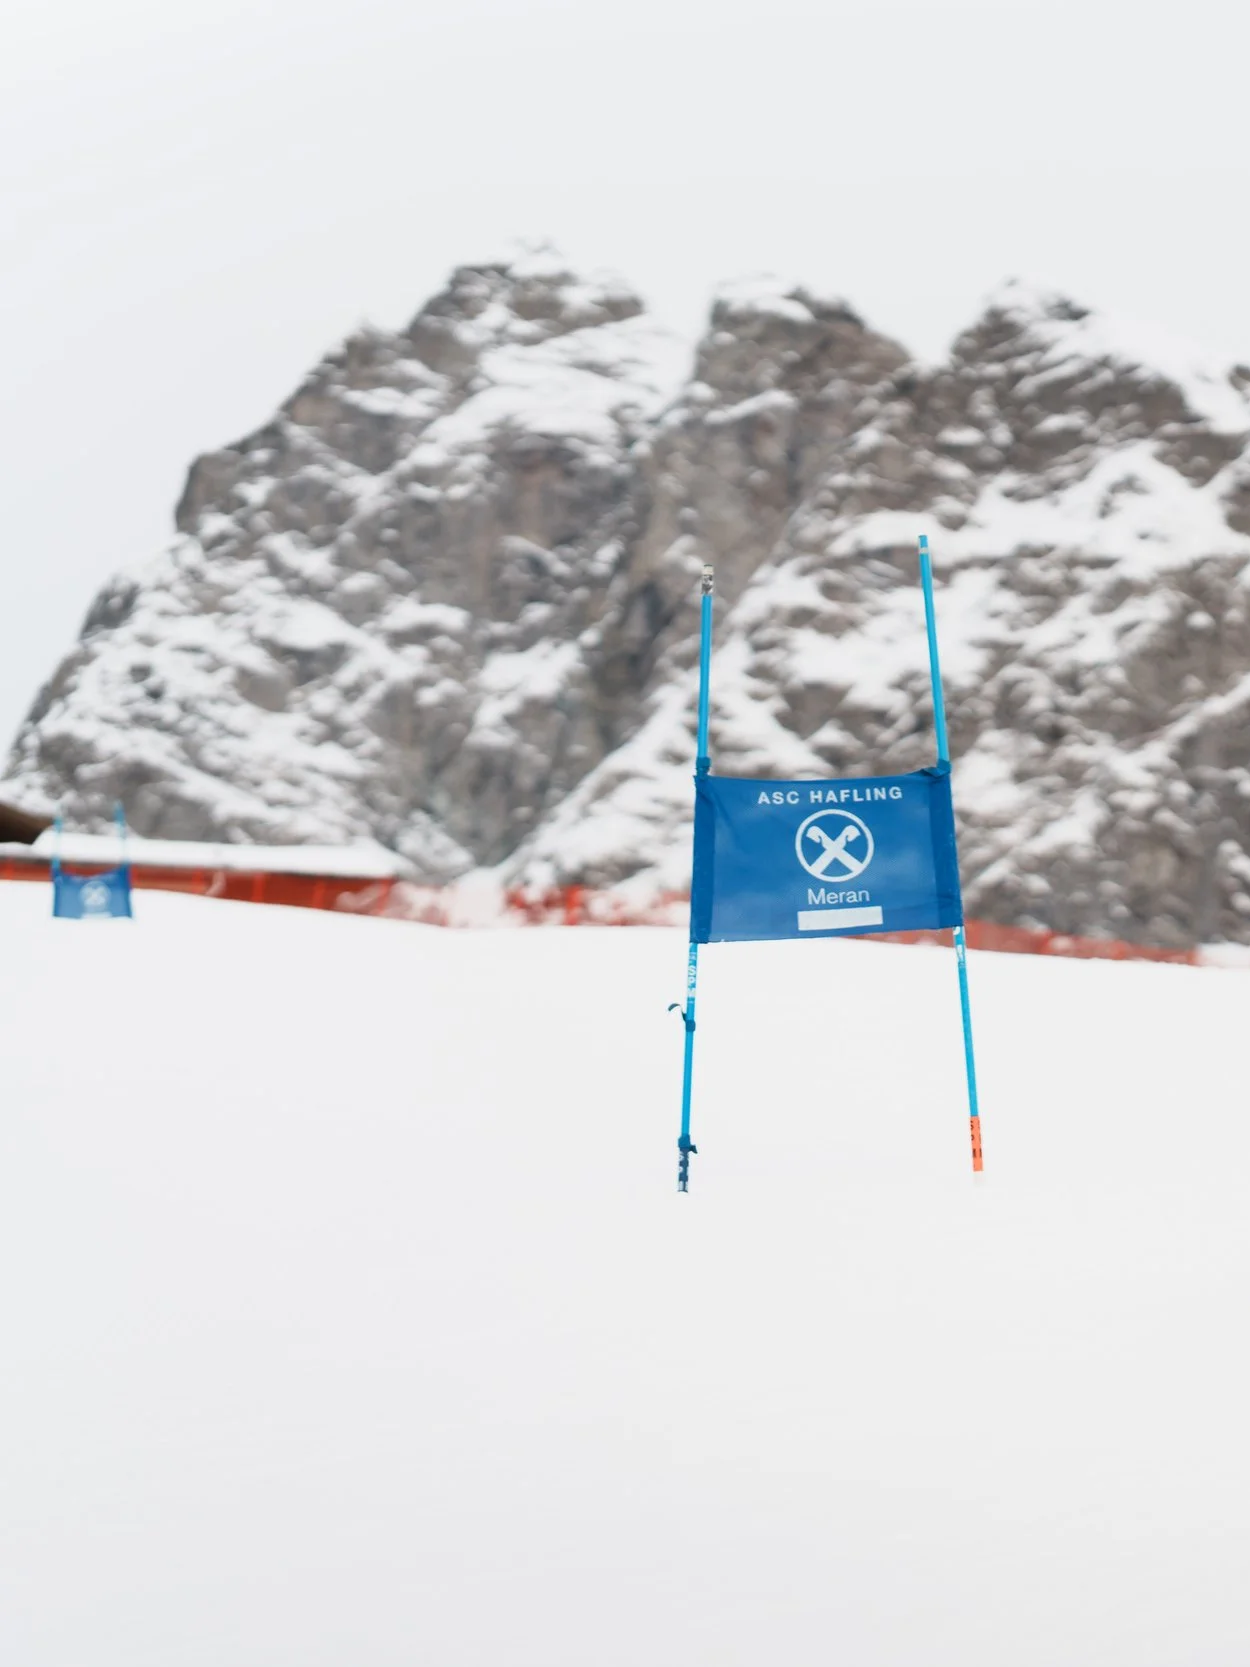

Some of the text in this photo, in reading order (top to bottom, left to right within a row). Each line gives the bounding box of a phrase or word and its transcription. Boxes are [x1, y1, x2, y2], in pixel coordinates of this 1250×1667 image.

[757, 786, 903, 805] ASC HAFLING
[807, 887, 870, 905] Meran
